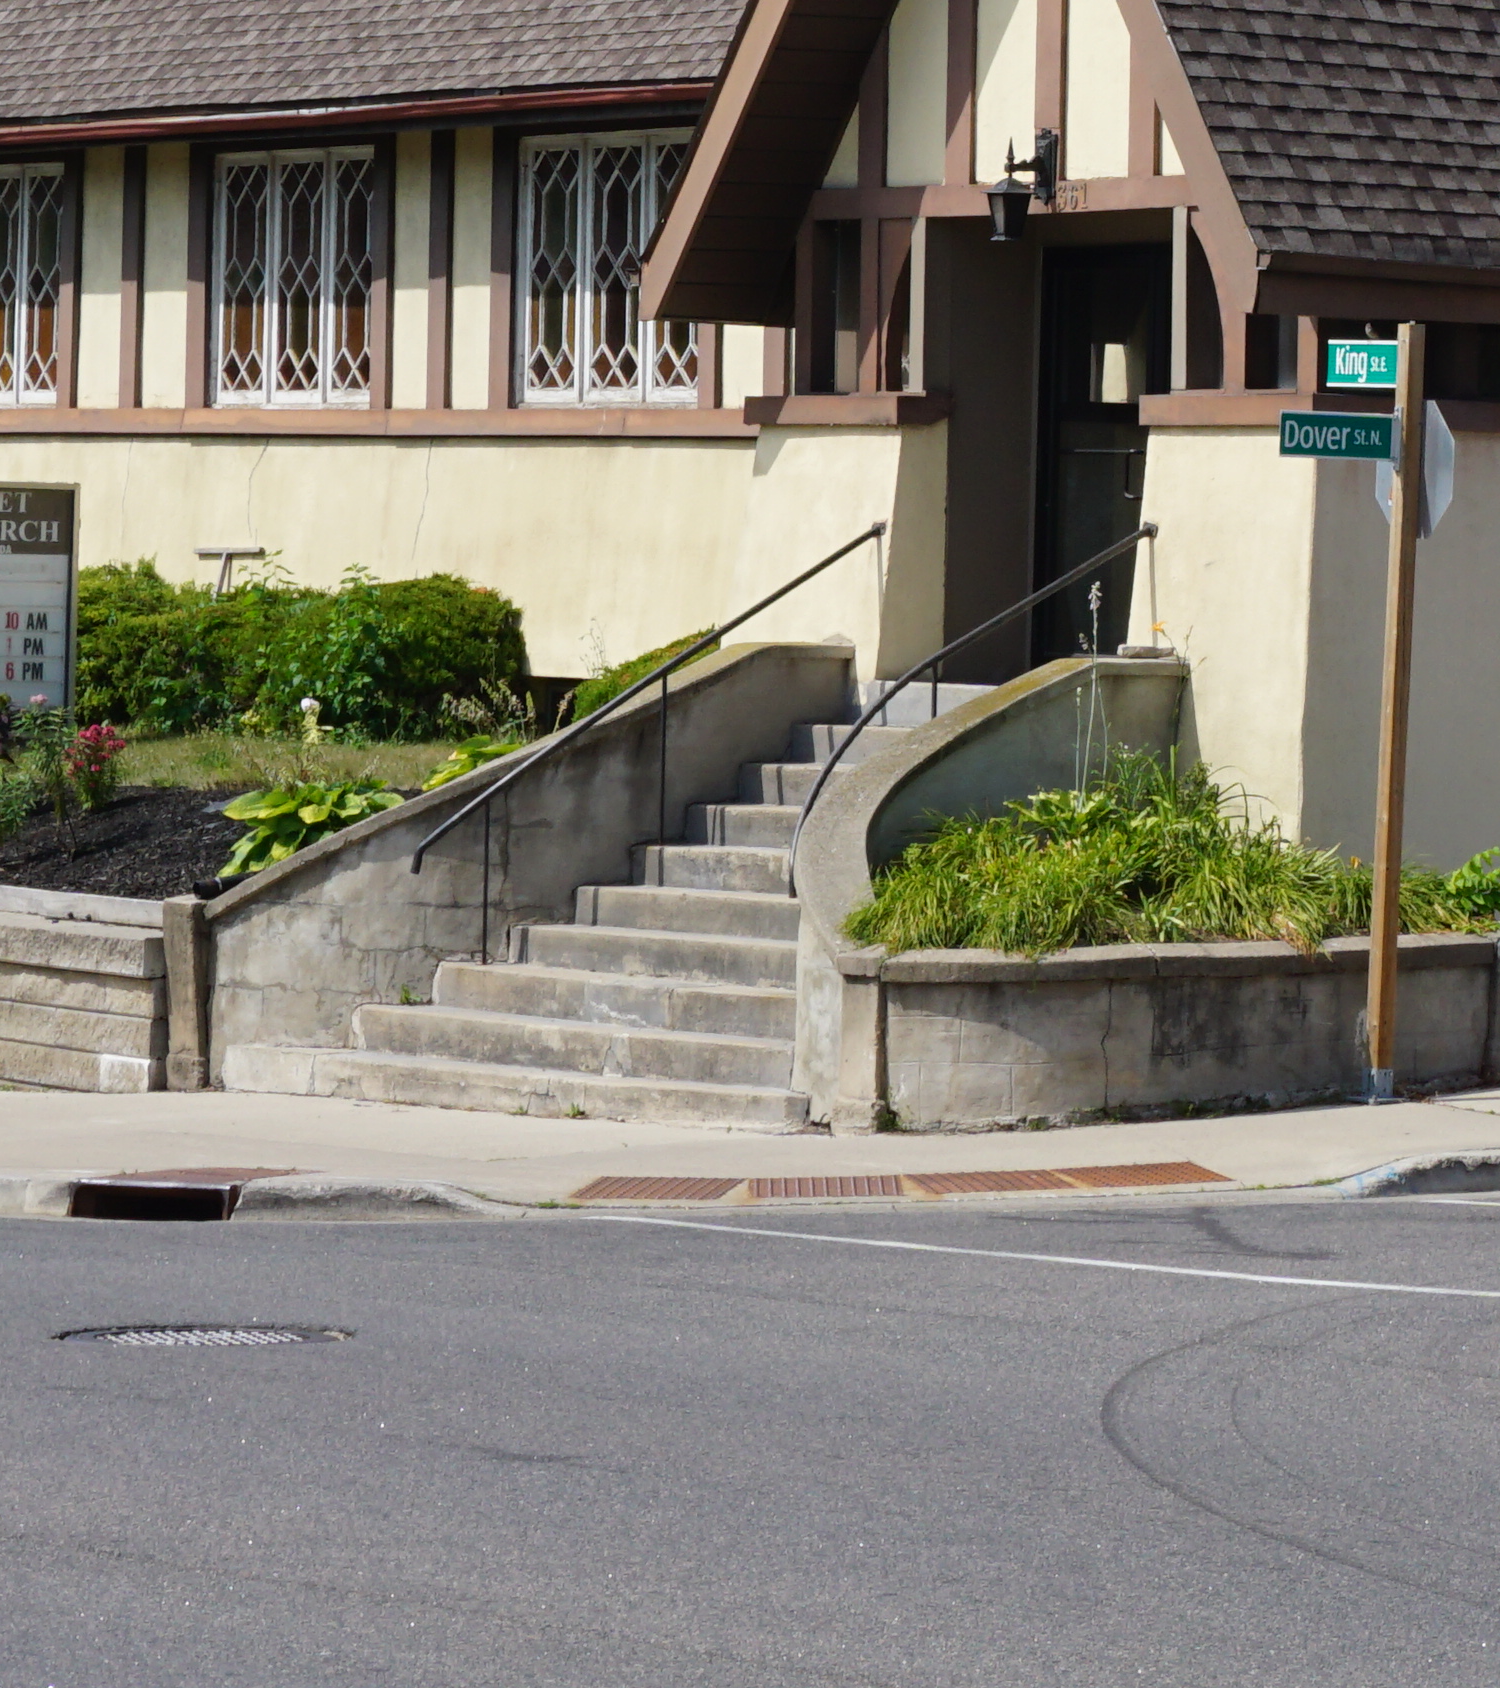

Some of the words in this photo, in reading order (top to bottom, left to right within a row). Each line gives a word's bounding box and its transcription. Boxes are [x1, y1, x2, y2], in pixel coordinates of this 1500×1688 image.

[1057, 182, 1088, 212] 361
[1335, 345, 1368, 383] King
[1284, 420, 1351, 450] Dover
[5, 612, 19, 630] 10
[26, 613, 48, 630] AM
[6, 637, 12, 655] 1
[23, 637, 44, 655] PM
[5, 662, 14, 680] 6
[22, 662, 44, 681] PM
